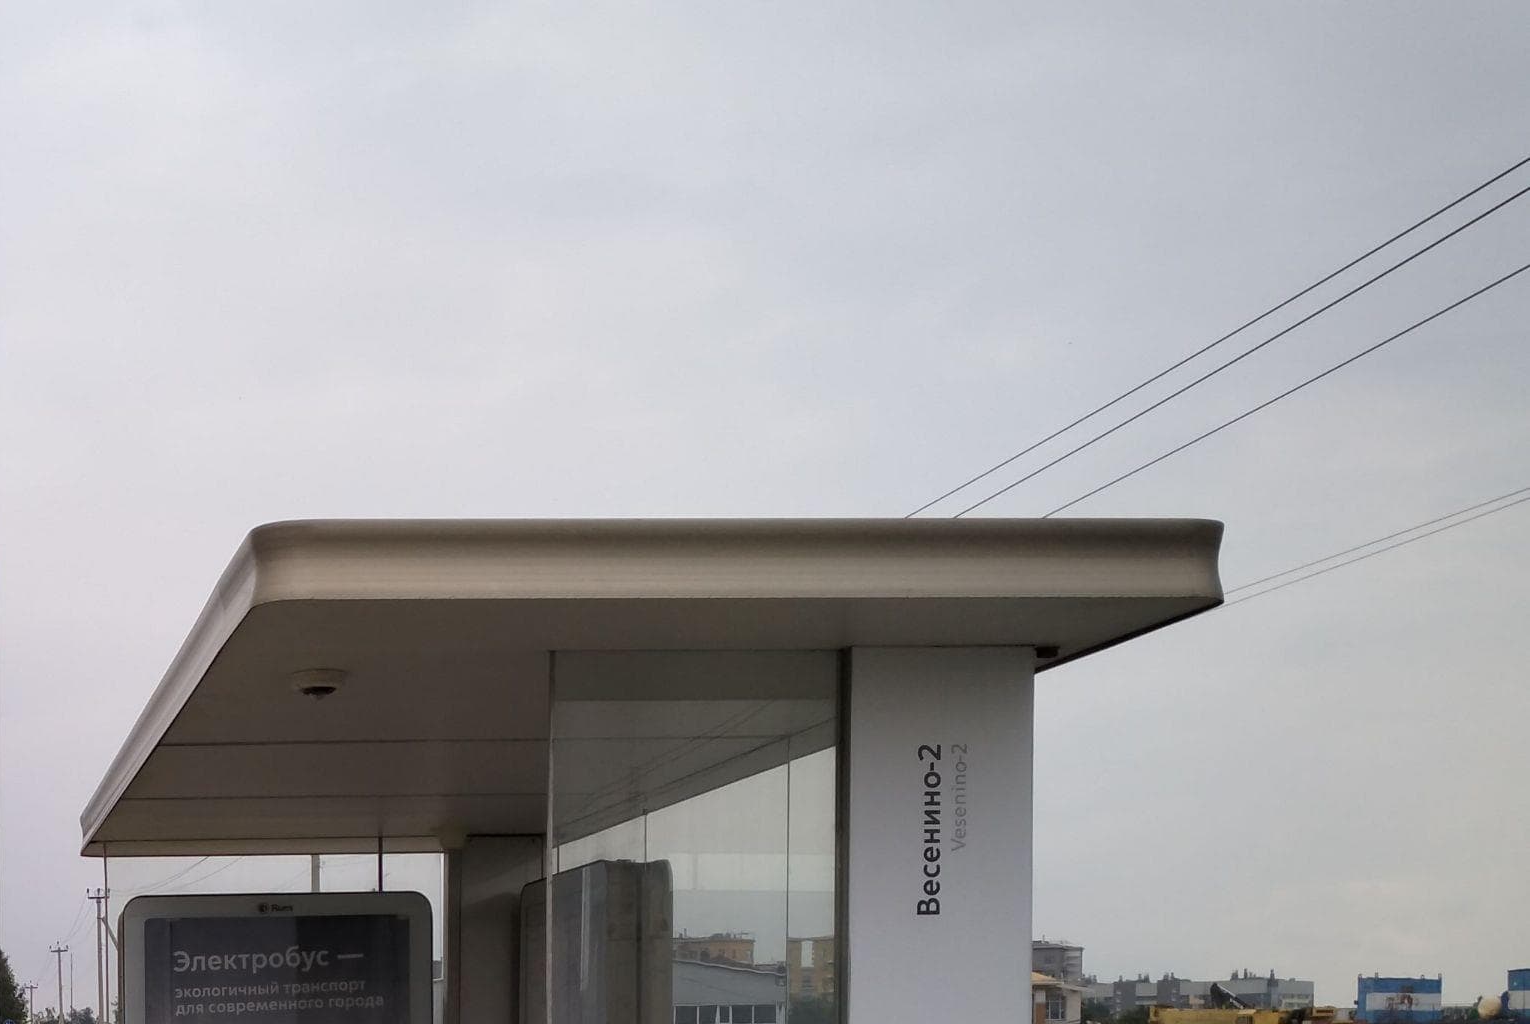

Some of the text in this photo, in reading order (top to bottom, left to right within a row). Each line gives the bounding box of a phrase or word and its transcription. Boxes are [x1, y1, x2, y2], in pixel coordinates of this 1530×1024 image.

[950, 743, 968, 851] Vesenino-2
[917, 744, 941, 915] Весенино-2
[173, 946, 329, 974] Электробус
[175, 979, 366, 998] экологичный транспорт
[176, 995, 385, 1016] для современного города
